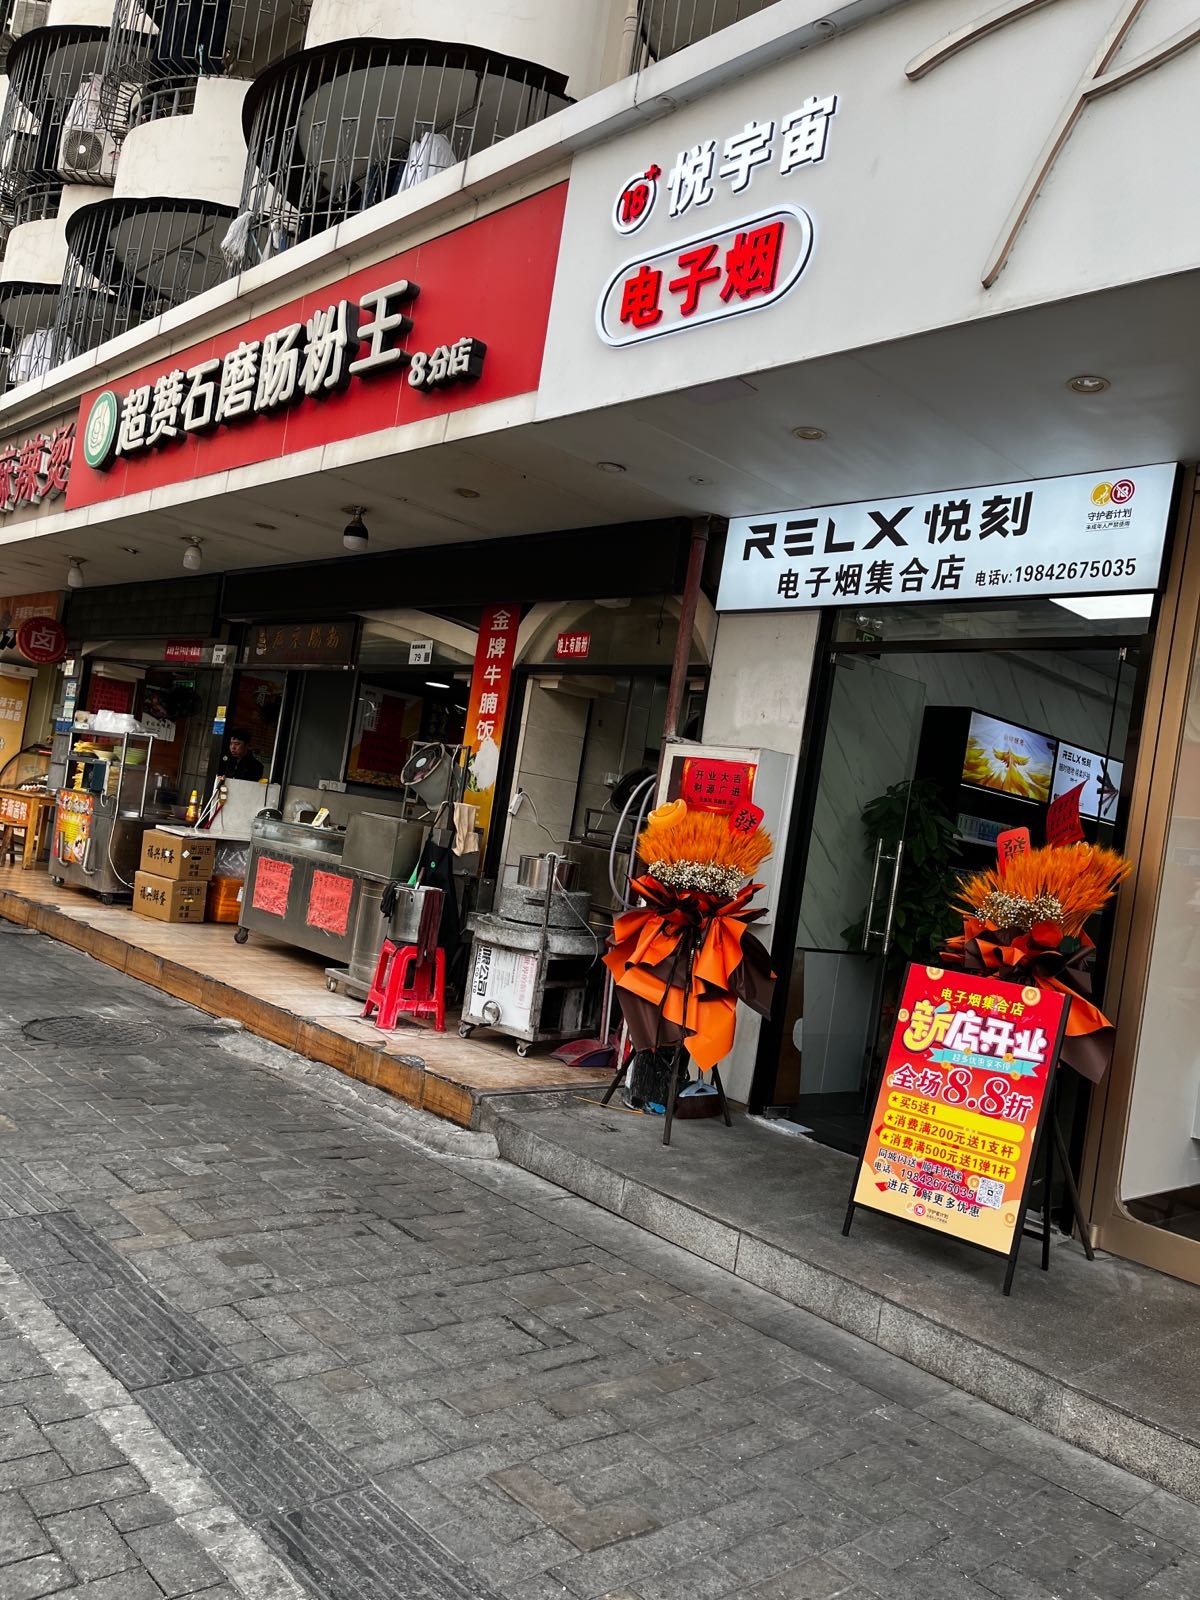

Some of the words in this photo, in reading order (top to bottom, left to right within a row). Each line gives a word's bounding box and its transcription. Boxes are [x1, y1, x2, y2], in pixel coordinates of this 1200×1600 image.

[667, 95, 838, 217] 悦宇宙
[620, 222, 785, 329] 电子烟
[115, 279, 416, 457] 超赞石磨肠粉王
[407, 338, 481, 390] 8分店
[743, 506, 913, 561] RELX
[923, 491, 1033, 545] 悦刻
[1087, 507, 1133, 521] 守护者计划
[776, 554, 966, 600] 电子烟集合店
[476, 609, 511, 742] 金牌牛腩饭
[695, 770, 742, 784] 开业大吉
[1061, 750, 1081, 764] RELX
[694, 783, 741, 797] 财源广进
[941, 988, 1025, 1016] 电子烟集合店
[903, 1000, 1048, 1061] 新店开业
[892, 1063, 1033, 1122] 全场8.8折
[900, 1095, 937, 1115] 买5送1
[890, 1133, 1011, 1179] 消费满500元送1弹1杆
[894, 1114, 1014, 1159] 消费满200元送1支杆
[878, 1148, 917, 1168] 同城闪送
[921, 1161, 963, 1181] 顺丰快递
[888, 1178, 981, 1218] 进店了解更多优惠
